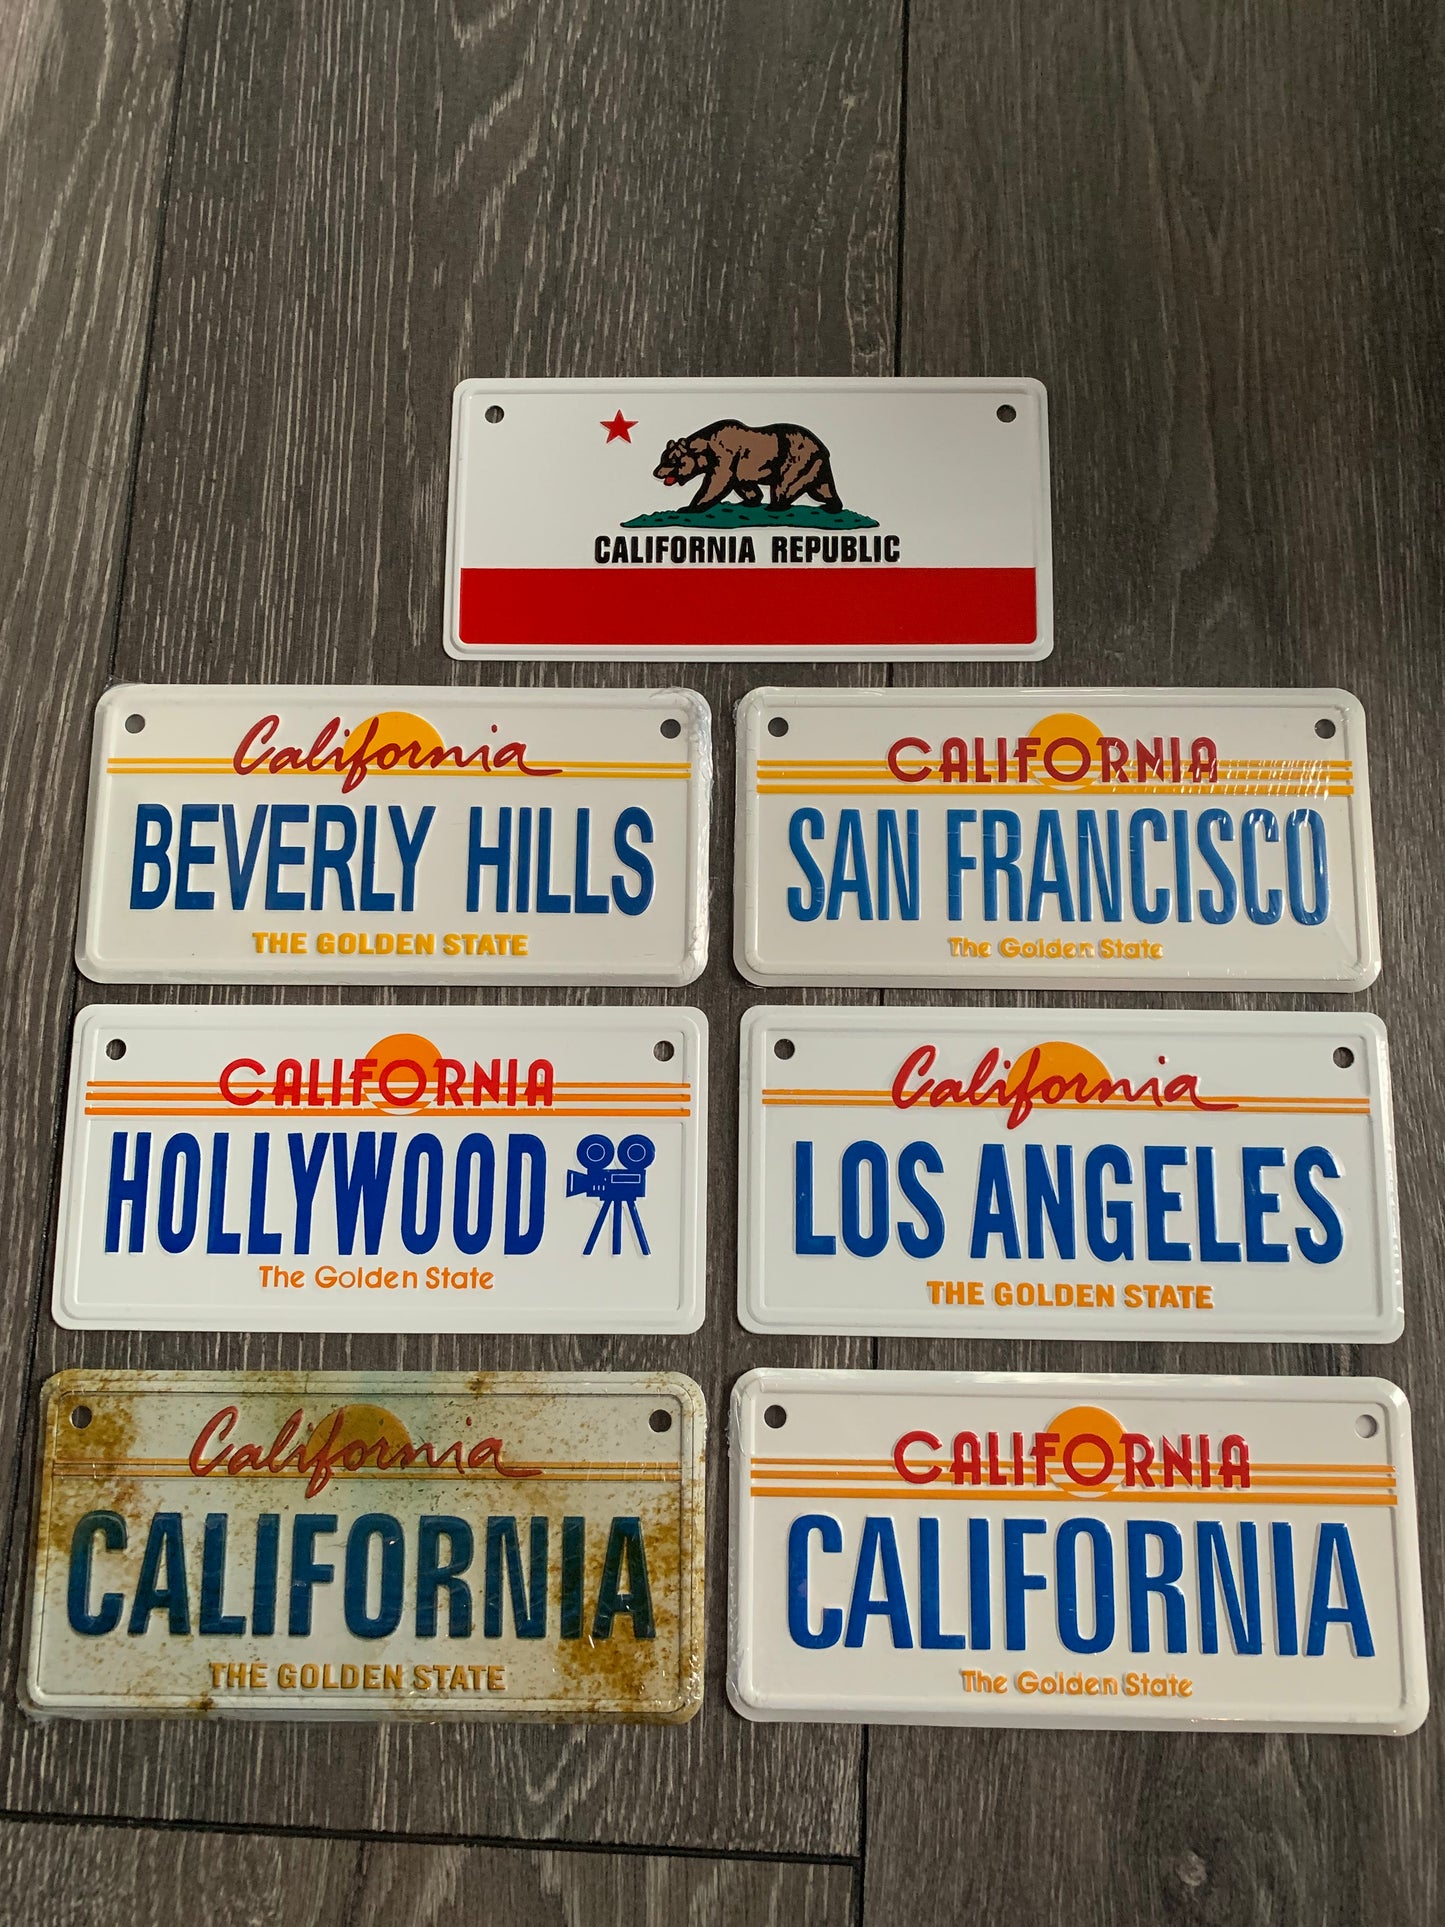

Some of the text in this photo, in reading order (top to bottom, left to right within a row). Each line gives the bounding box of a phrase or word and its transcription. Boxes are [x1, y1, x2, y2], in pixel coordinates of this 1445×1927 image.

[595, 536, 902, 563] CALIFORNIA REPUBLIC
[233, 715, 563, 793] California
[888, 737, 1219, 783] CALIFORNIA
[130, 804, 654, 915] BEVERLY HILLS
[788, 807, 1331, 925] SAN FRANCISCO
[252, 932, 528, 956] THE GOLDEN STATE
[949, 938, 1164, 959] The Golden State
[221, 1059, 554, 1106] CALIFORNIA
[892, 1045, 1239, 1129] California
[105, 1132, 547, 1255] HOLLYWOOD
[795, 1140, 1342, 1264] LOS ANGELES
[258, 1266, 495, 1290] The Golden State
[927, 1282, 1215, 1309] THE GOLDEN STATE
[191, 1406, 543, 1498] California
[894, 1430, 1251, 1488] CALIFORNIA
[69, 1510, 655, 1640] CALIFORNIA
[789, 1514, 1375, 1657] CALIFORNIA
[211, 1663, 505, 1691] THE GOLDEN STATE
[961, 1670, 1194, 1698] The Golden State
